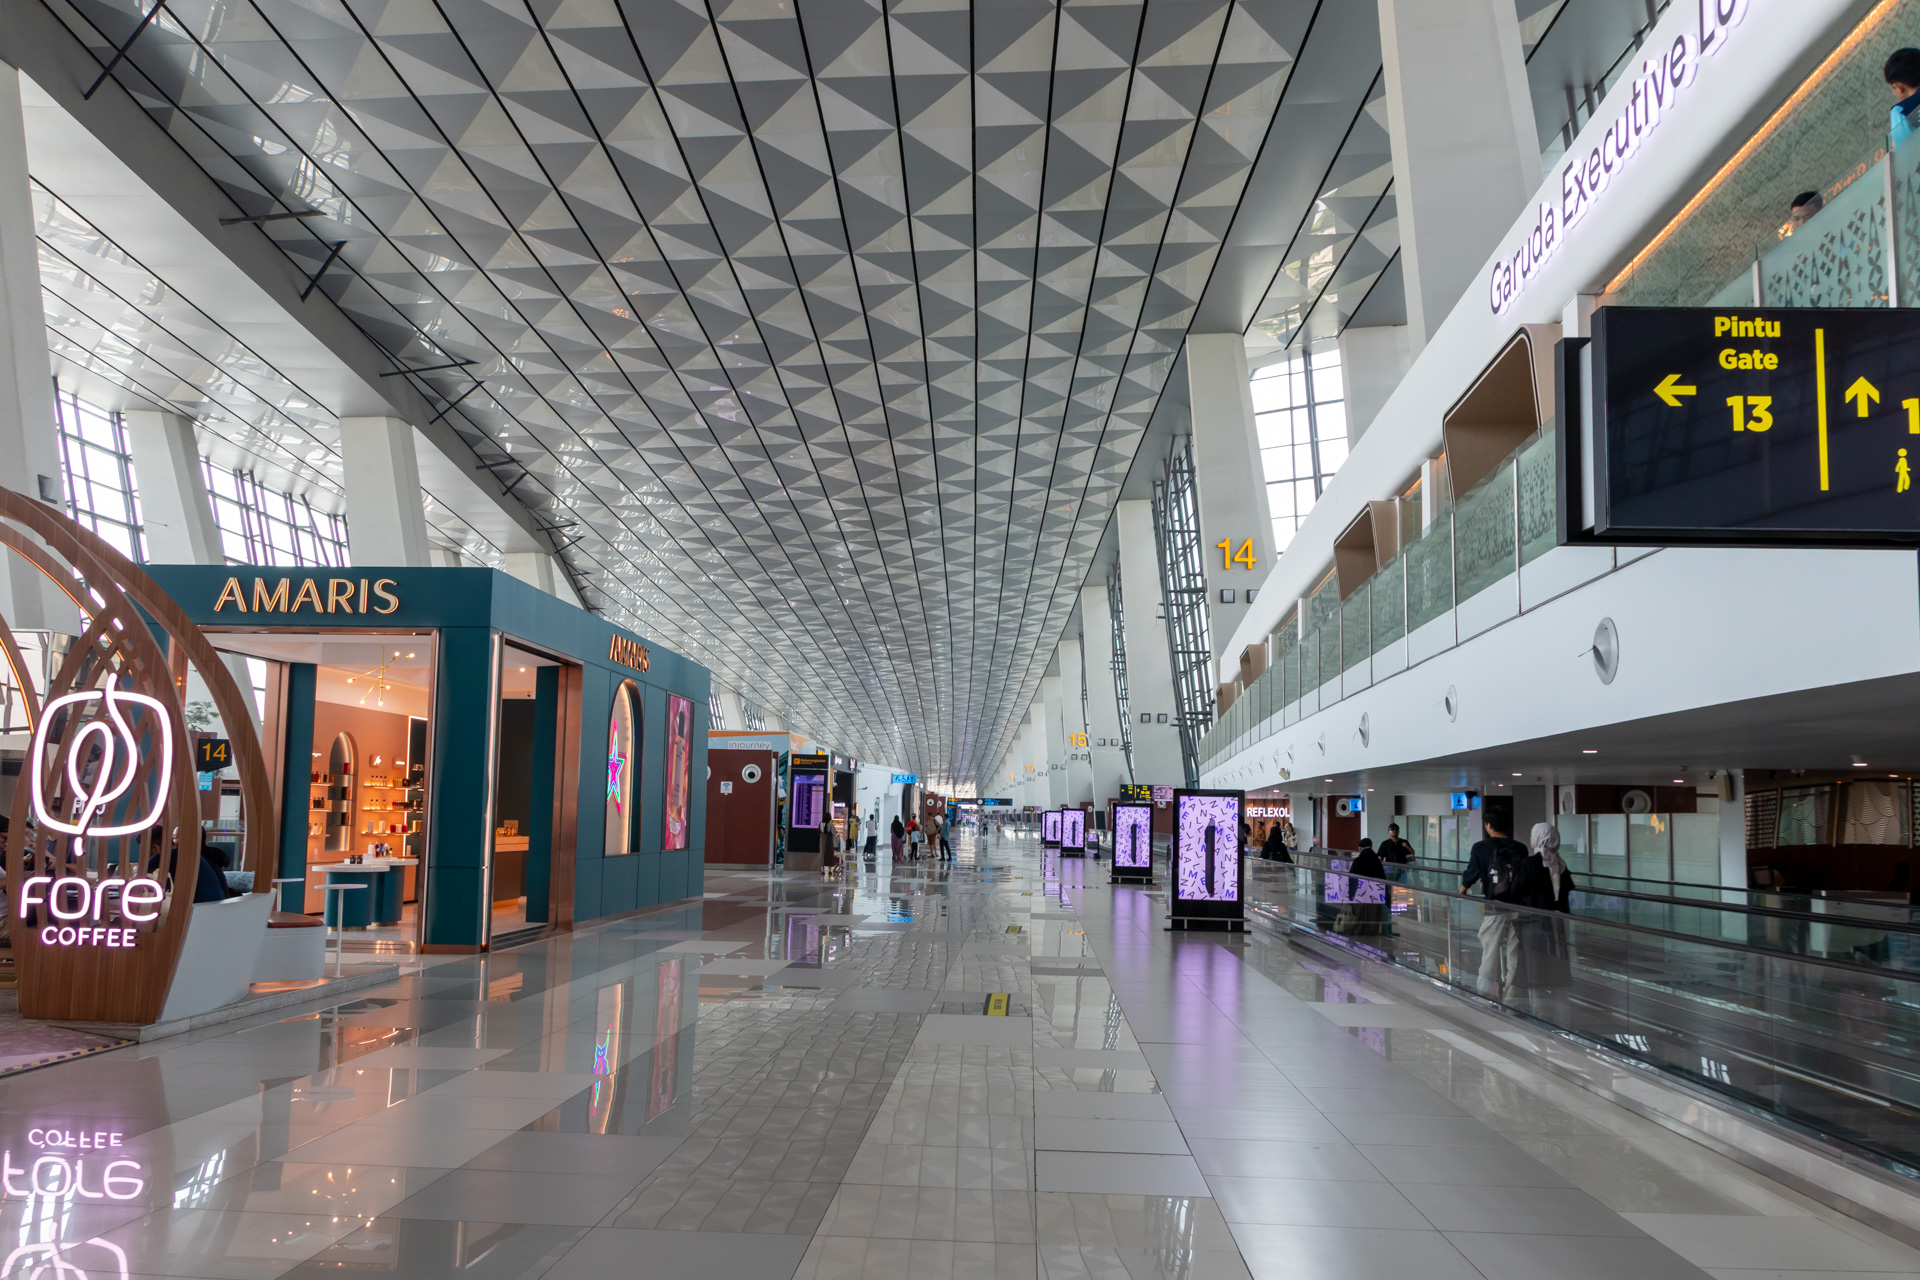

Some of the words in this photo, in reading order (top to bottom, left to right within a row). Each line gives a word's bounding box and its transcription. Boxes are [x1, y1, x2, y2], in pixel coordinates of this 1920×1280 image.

[1490, 201, 1563, 315] Garuda
[1562, 34, 1698, 230] Executive
[1714, 316, 1781, 338] Pintu
[1718, 348, 1779, 370] Gate
[1726, 395, 1774, 432] 13
[1217, 537, 1258, 570] 14
[213, 576, 400, 615] AMARIS
[609, 633, 651, 674] AMARIS
[1068, 732, 1088, 747] 15
[201, 742, 227, 762] 14
[1246, 807, 1290, 818] REFLEXOL
[41, 926, 137, 947] COFFEE
